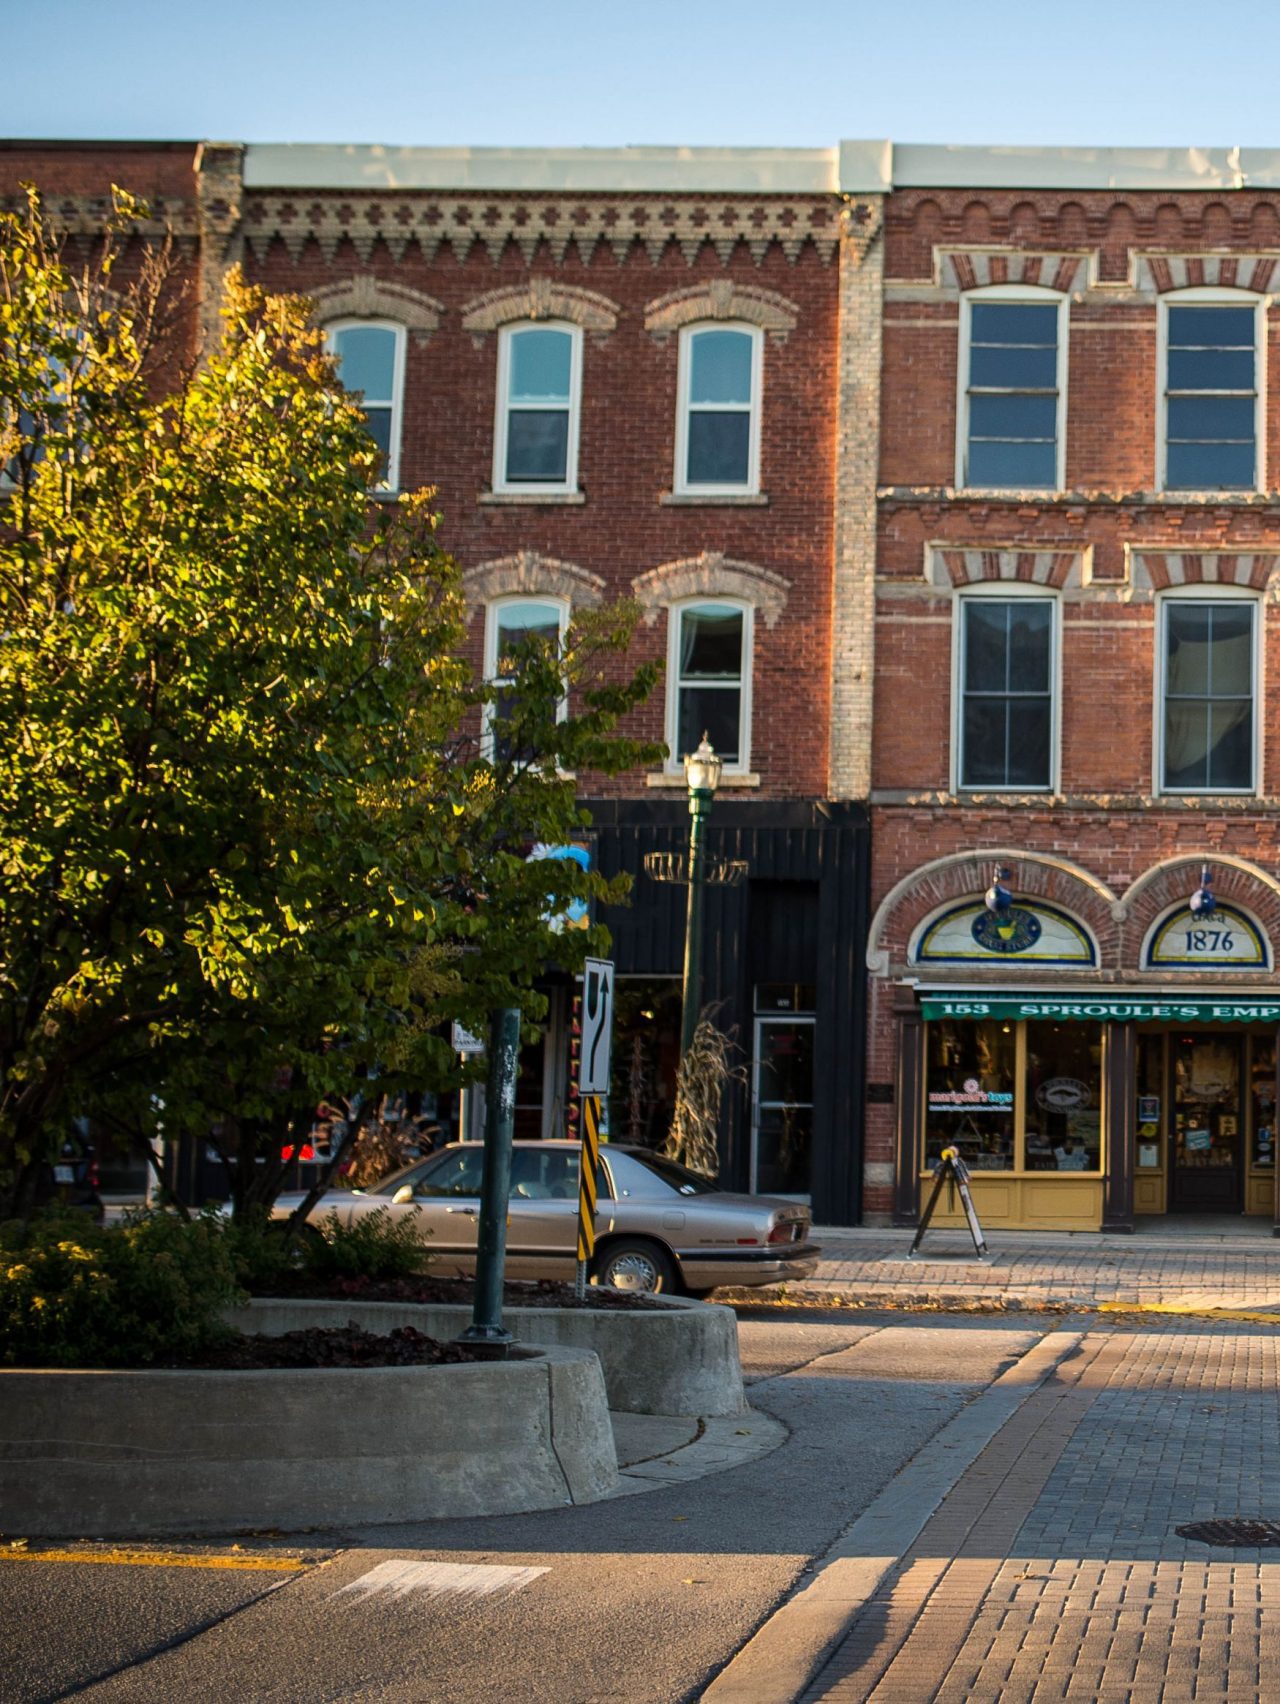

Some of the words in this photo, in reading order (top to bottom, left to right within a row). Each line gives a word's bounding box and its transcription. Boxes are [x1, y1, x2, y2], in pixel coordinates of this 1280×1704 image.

[1186, 929, 1234, 952] 1876
[942, 1004, 990, 1014] 153
[1020, 1004, 1199, 1017] SPROULE'S
